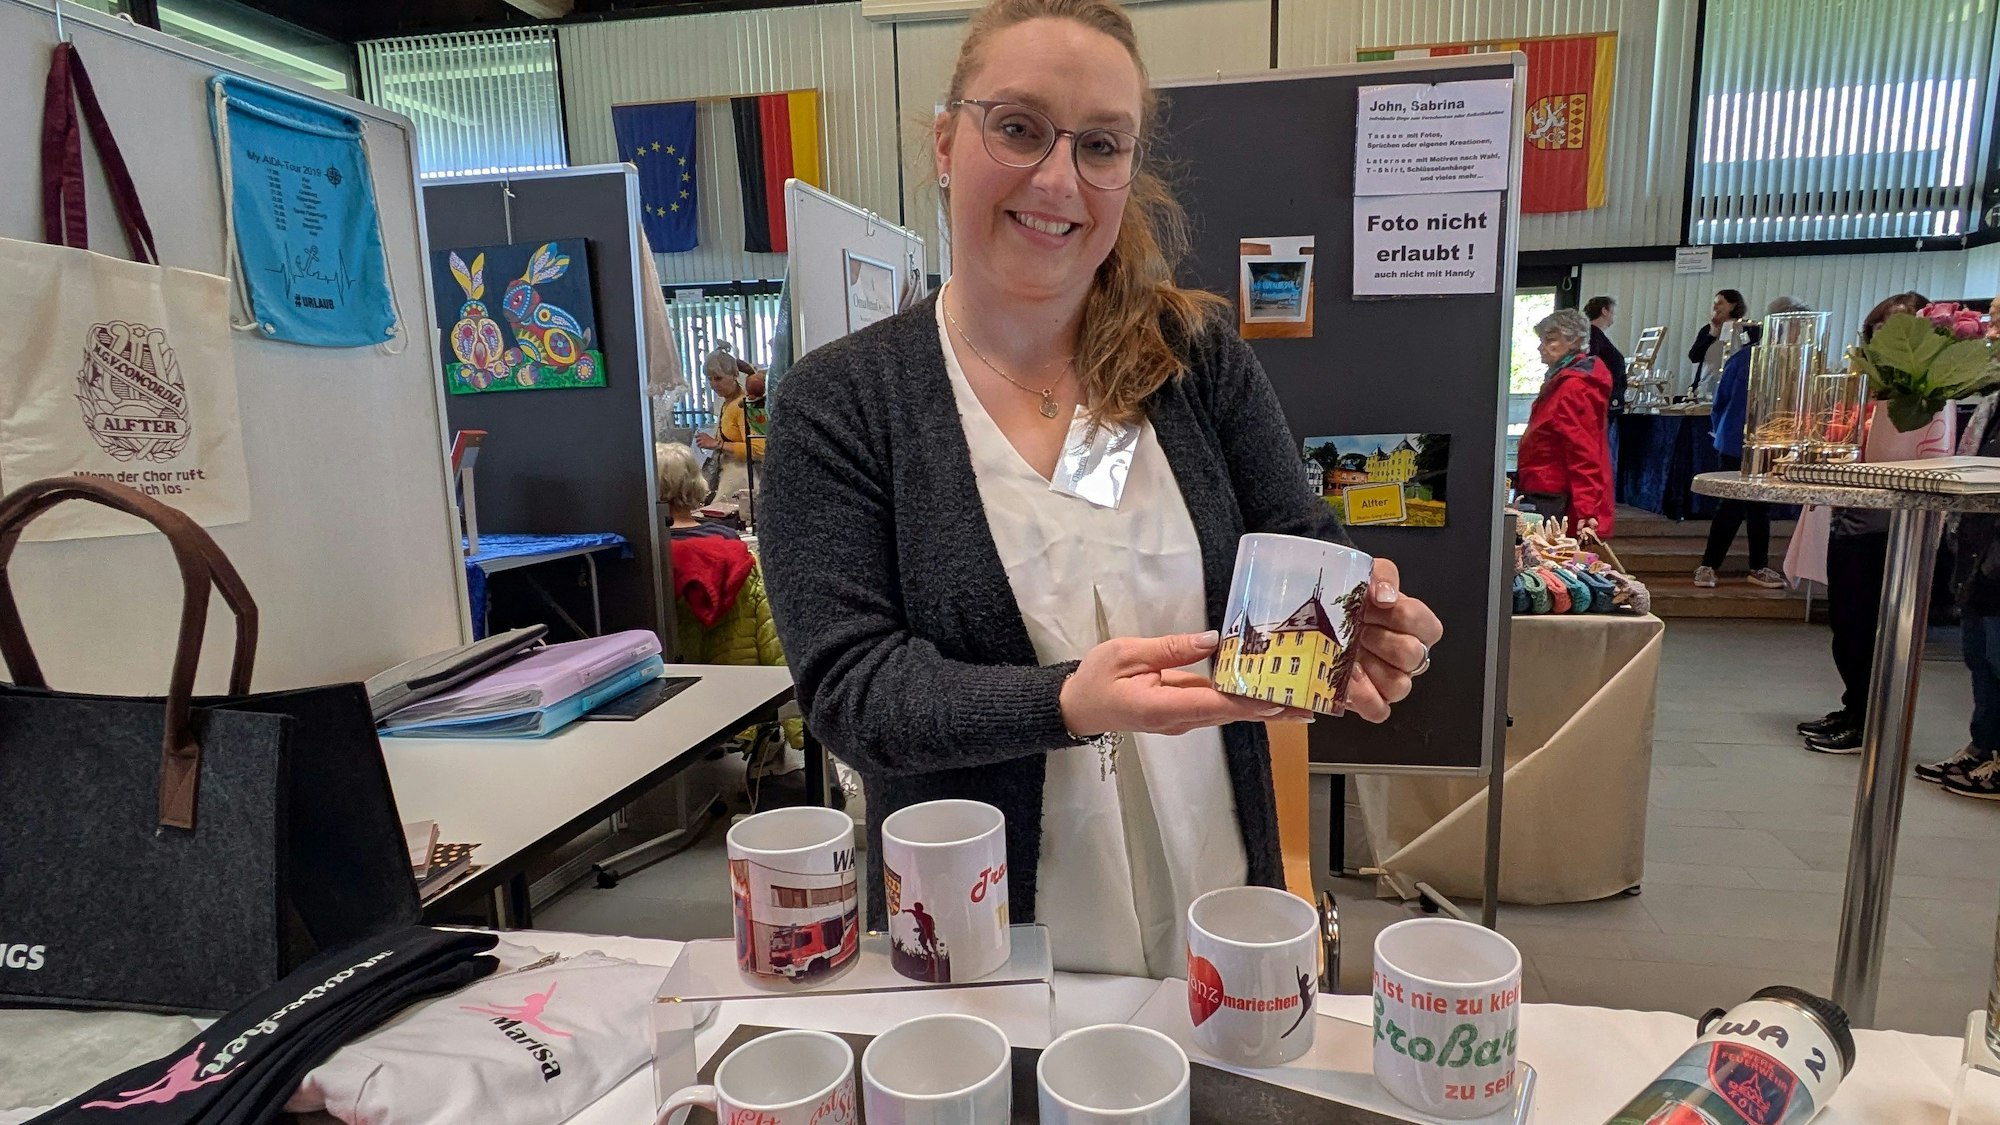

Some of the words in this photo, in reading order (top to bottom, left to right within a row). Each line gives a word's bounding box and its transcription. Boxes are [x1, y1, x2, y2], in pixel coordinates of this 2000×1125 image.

[1370, 100, 1406, 114] John,
[1411, 100, 1465, 112] Sabrina
[1367, 142, 1400, 150] Sprüchen
[246, 150, 260, 164] My
[303, 166, 322, 177] 2019
[1406, 164, 1475, 173] Schlüsselanhänger
[1367, 214, 1419, 232] Foto
[1427, 212, 1488, 230] nicht
[1376, 244, 1460, 262] erlaubt
[1468, 244, 1474, 260] !
[1374, 270, 1398, 278] auch
[1400, 270, 1424, 278] nicht
[1426, 270, 1443, 278] mit
[1445, 269, 1476, 278] Handy
[294, 293, 335, 310] #URLAUB
[104, 416, 178, 434] ALFTER
[117, 470, 139, 483] der
[142, 469, 173, 482] Chor
[176, 468, 206, 481] ruft
[141, 483, 160, 495] ich
[163, 482, 183, 495] los
[1361, 499, 1388, 508] Alfter
[1223, 994, 1298, 1012] mariechen
[1382, 974, 1404, 1004] ist
[1411, 991, 1448, 1014] nie
[1456, 998, 1483, 1016] zu
[489, 1016, 561, 1083] Marisa
[1716, 1019, 1789, 1048] WA
[1804, 1047, 1826, 1084] 2
[1444, 1084, 1476, 1100] zu
